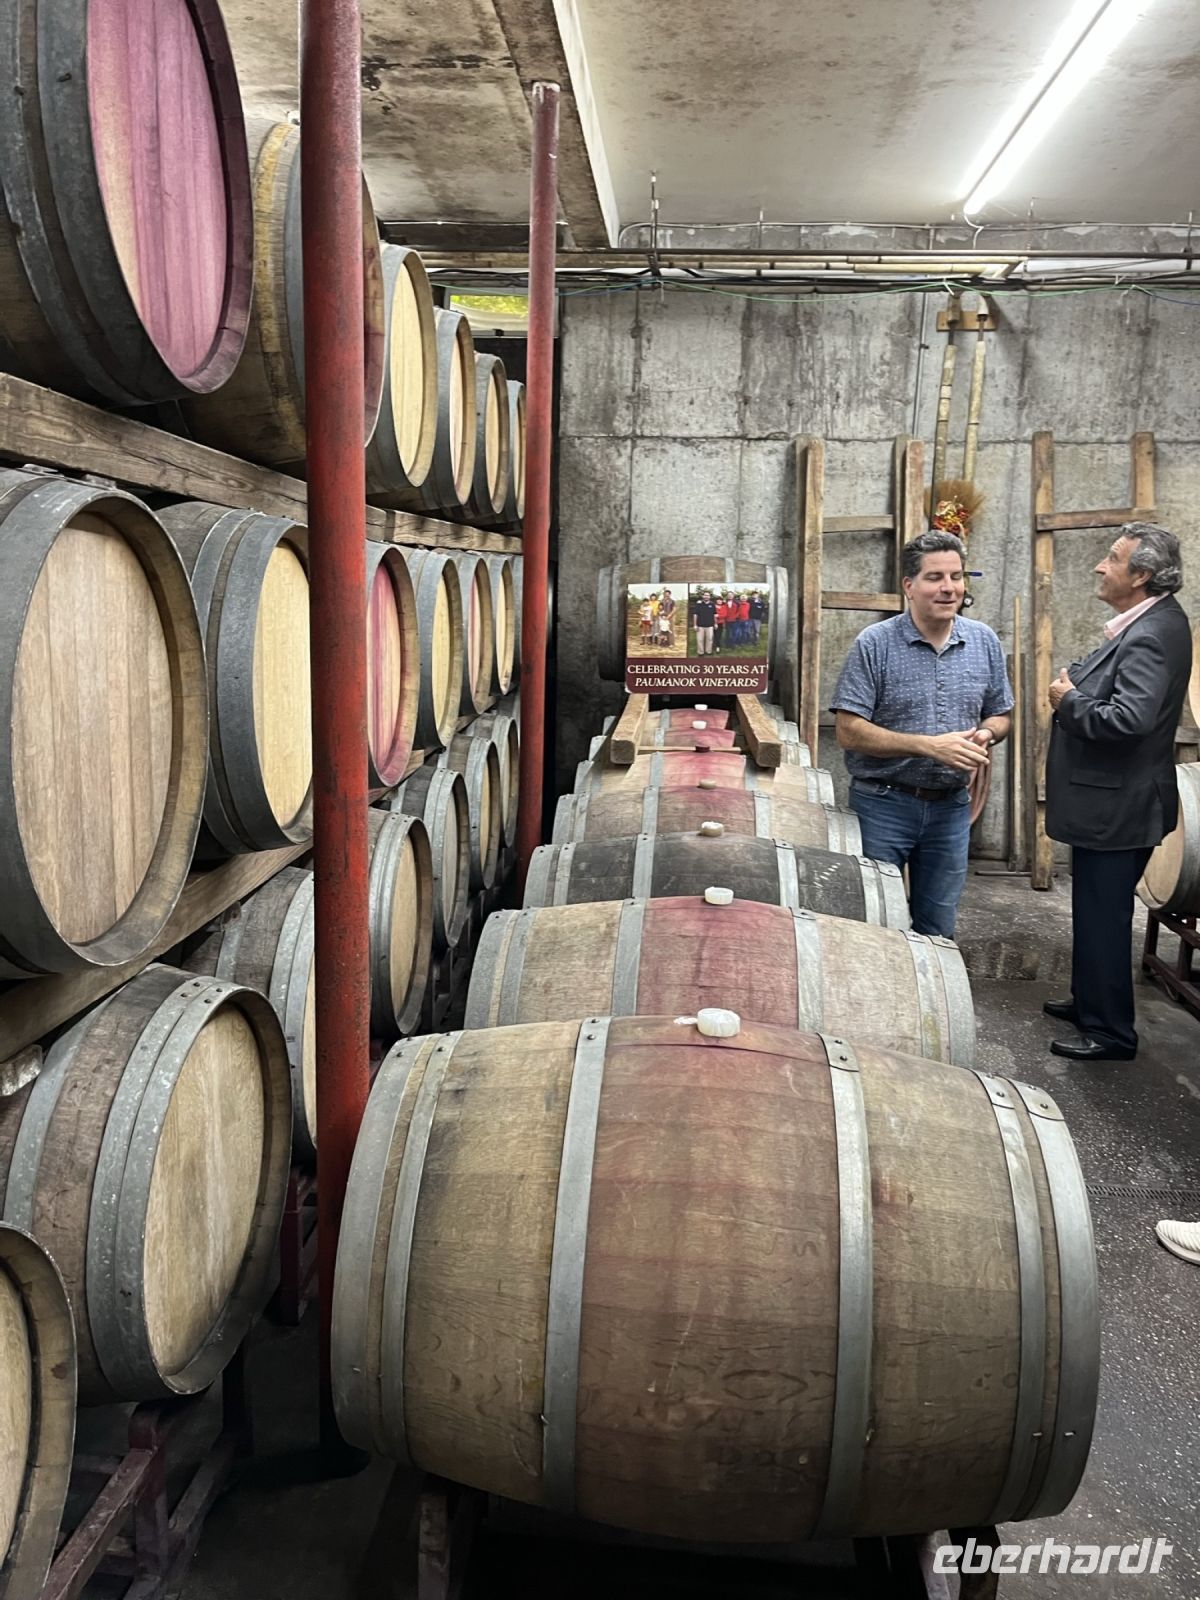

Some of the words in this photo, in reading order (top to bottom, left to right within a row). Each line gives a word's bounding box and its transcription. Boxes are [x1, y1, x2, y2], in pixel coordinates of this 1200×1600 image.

[627, 664, 700, 674] CELEBRATING
[702, 664, 714, 674] 30
[716, 664, 749, 674] YEARS
[750, 664, 766, 674] AT
[635, 677, 696, 687] PAUMANOK
[699, 677, 759, 687] VINEYARDS
